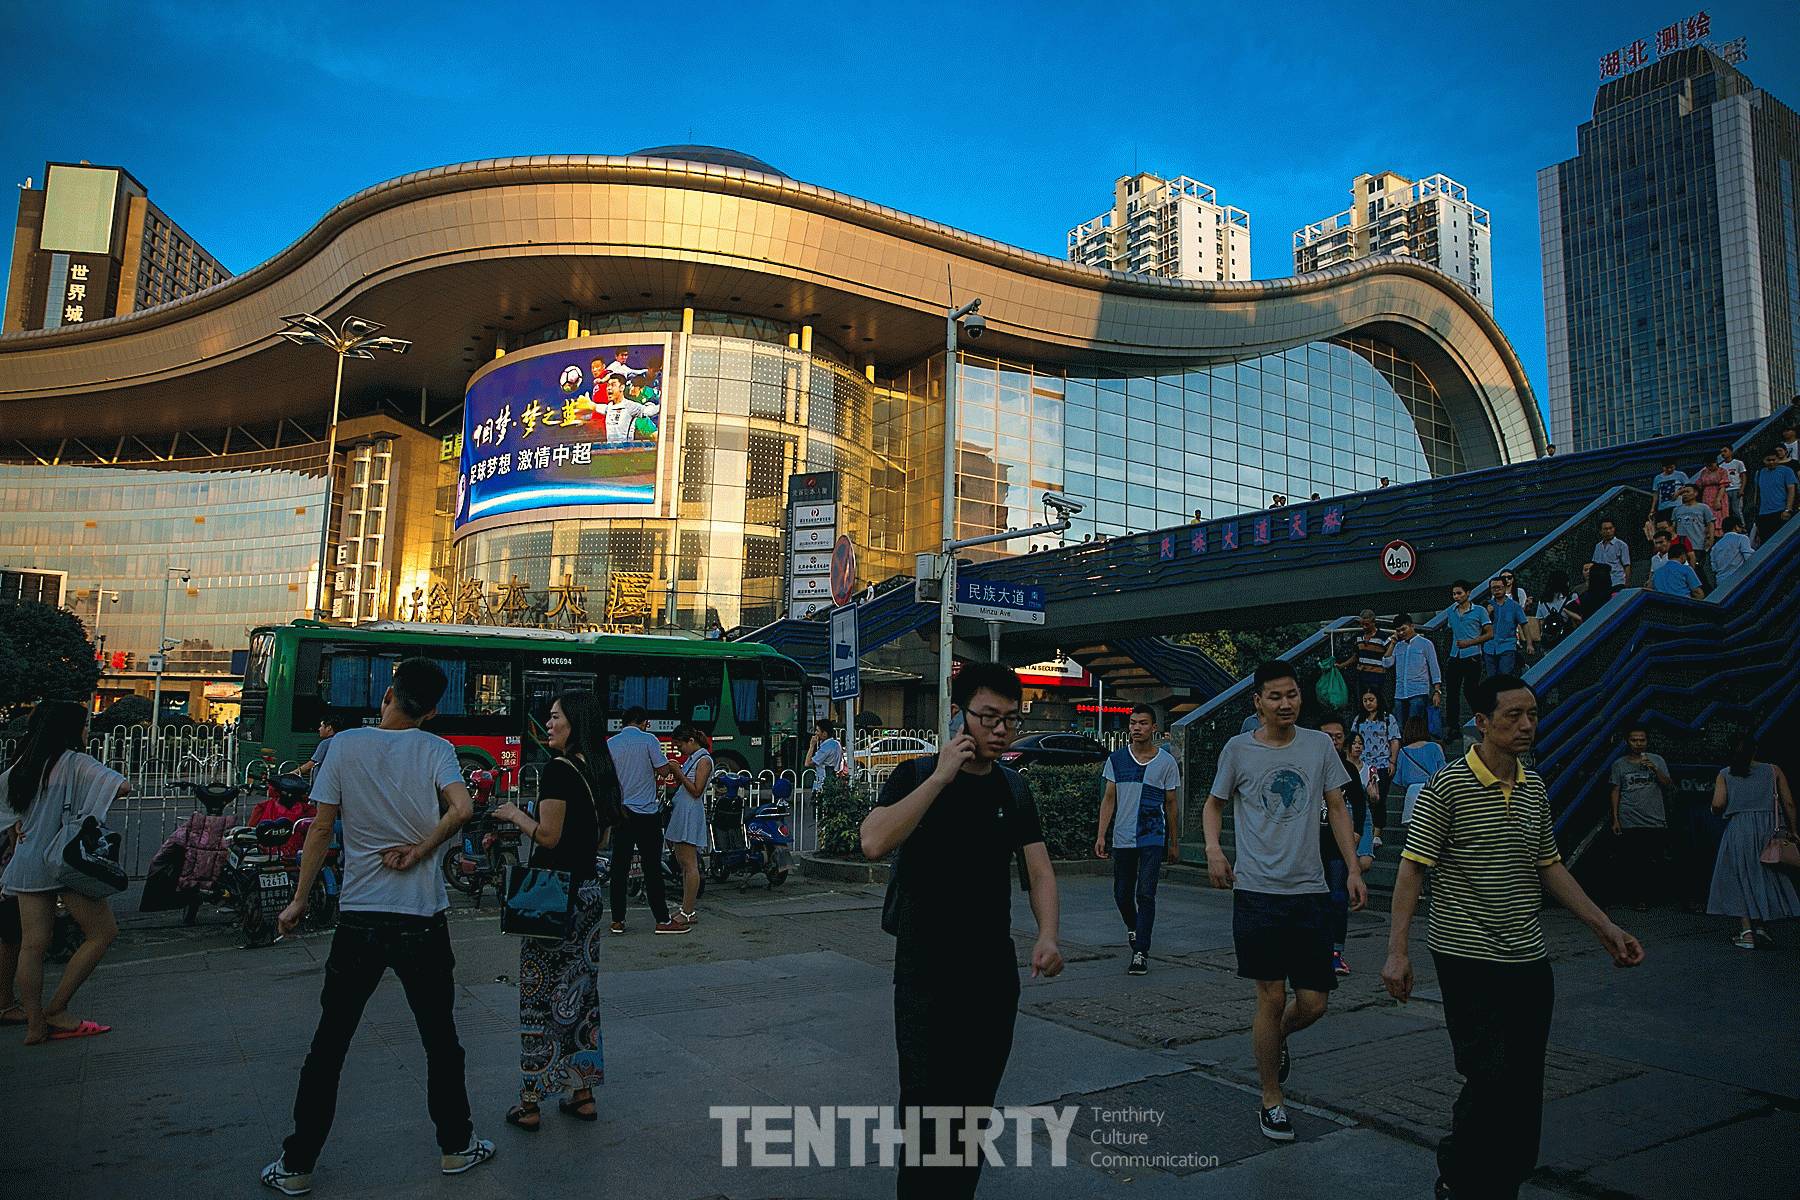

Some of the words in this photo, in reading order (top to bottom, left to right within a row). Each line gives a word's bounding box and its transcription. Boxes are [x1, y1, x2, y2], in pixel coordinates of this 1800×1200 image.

[1600, 10, 1711, 80] 湖北测绘
[65, 264, 90, 322] 世界城
[469, 453, 512, 486] 足球梦想
[516, 442, 592, 472] 激情中超
[953, 603, 960, 613] N
[980, 606, 998, 617] Minzu
[1000, 608, 1011, 618] Ave
[1032, 613, 1038, 621] S
[968, 583, 1025, 606] 民族大道
